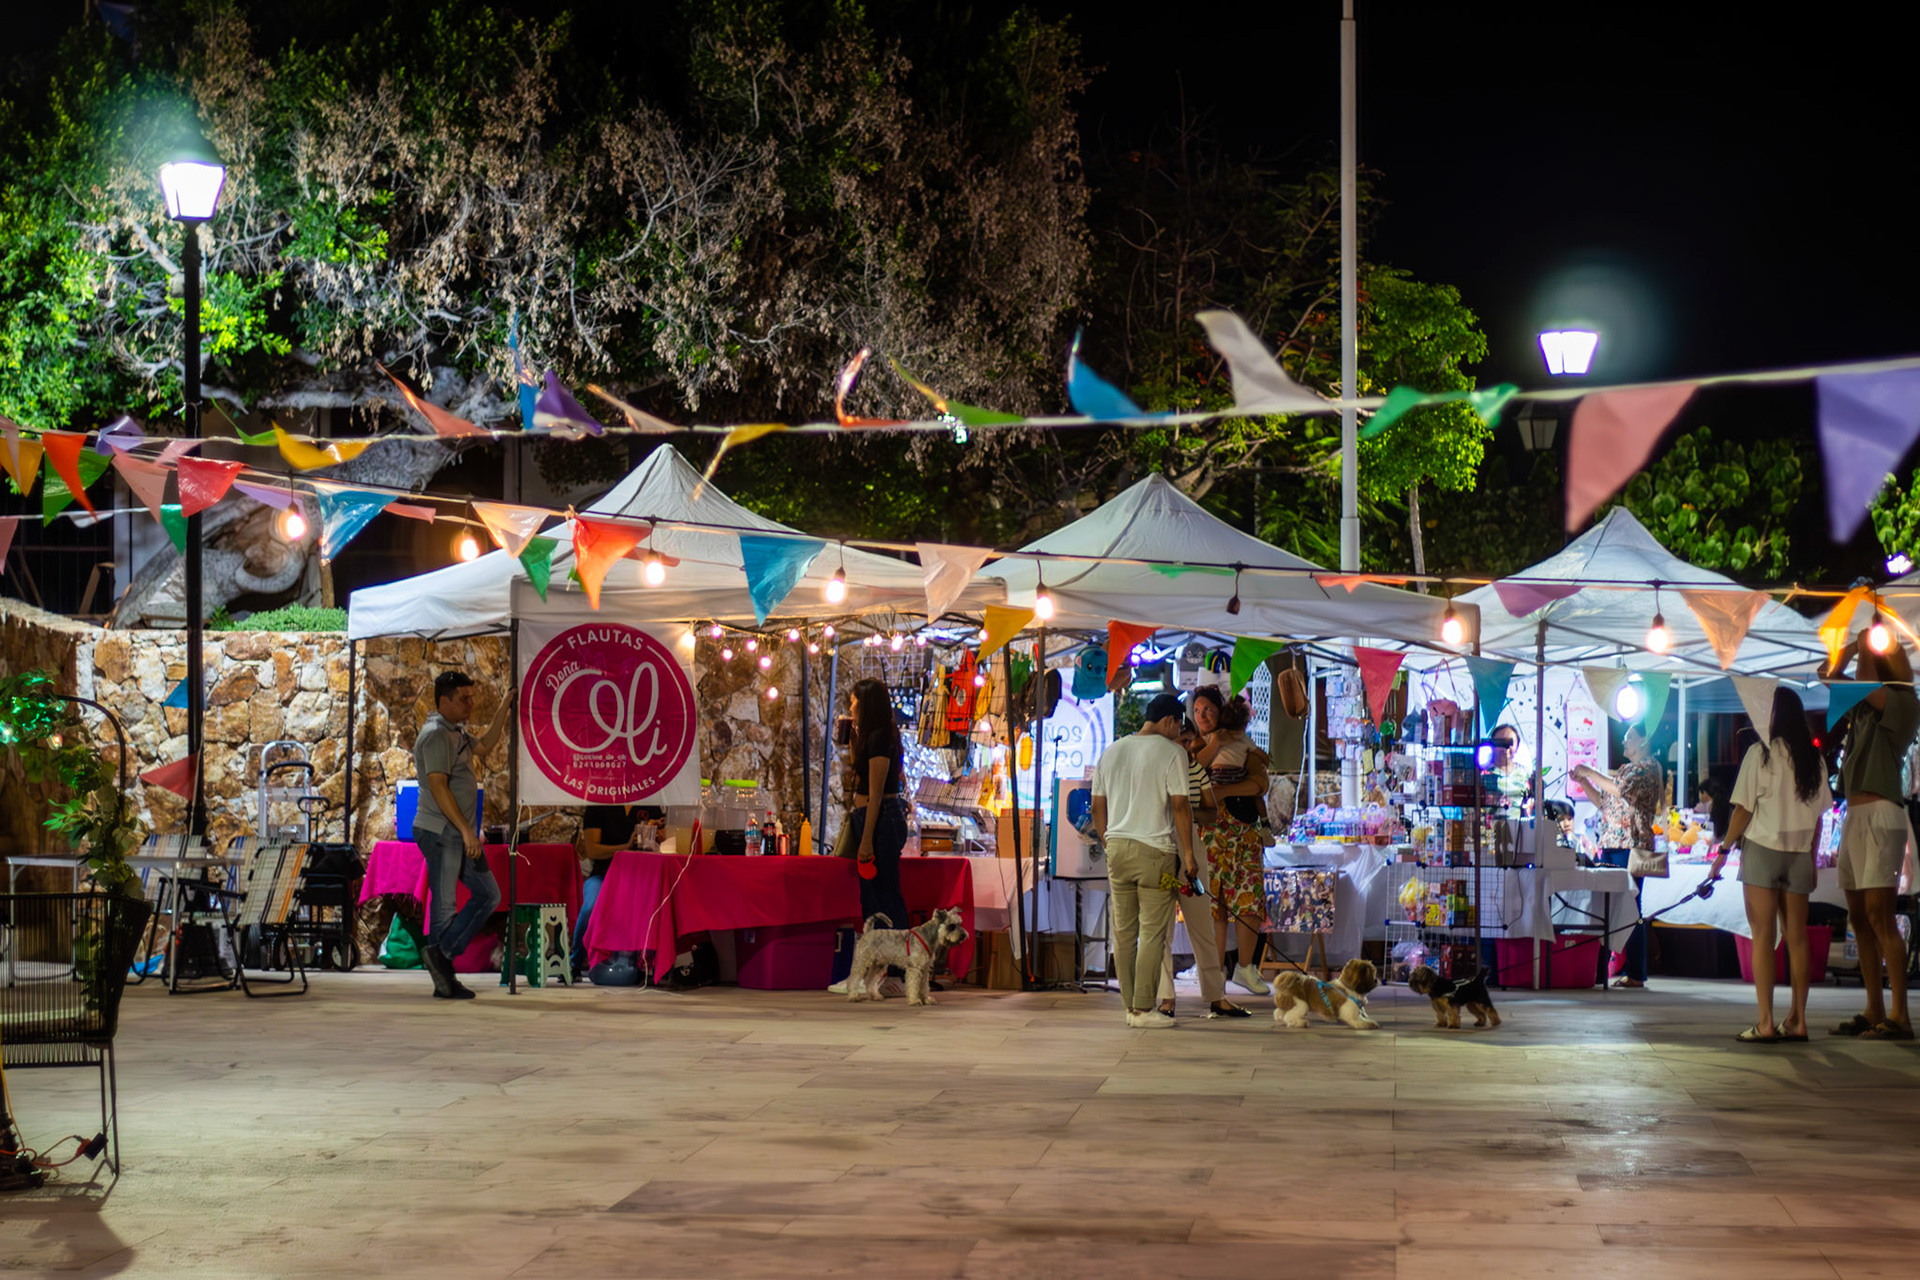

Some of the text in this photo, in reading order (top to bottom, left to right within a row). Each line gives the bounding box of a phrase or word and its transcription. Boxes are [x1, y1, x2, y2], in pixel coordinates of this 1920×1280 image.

[567, 629, 644, 650] FLAUTAS
[545, 660, 581, 691] Doña
[552, 662, 667, 765] Oli
[563, 774, 656, 796] LAS ORIGINALES
